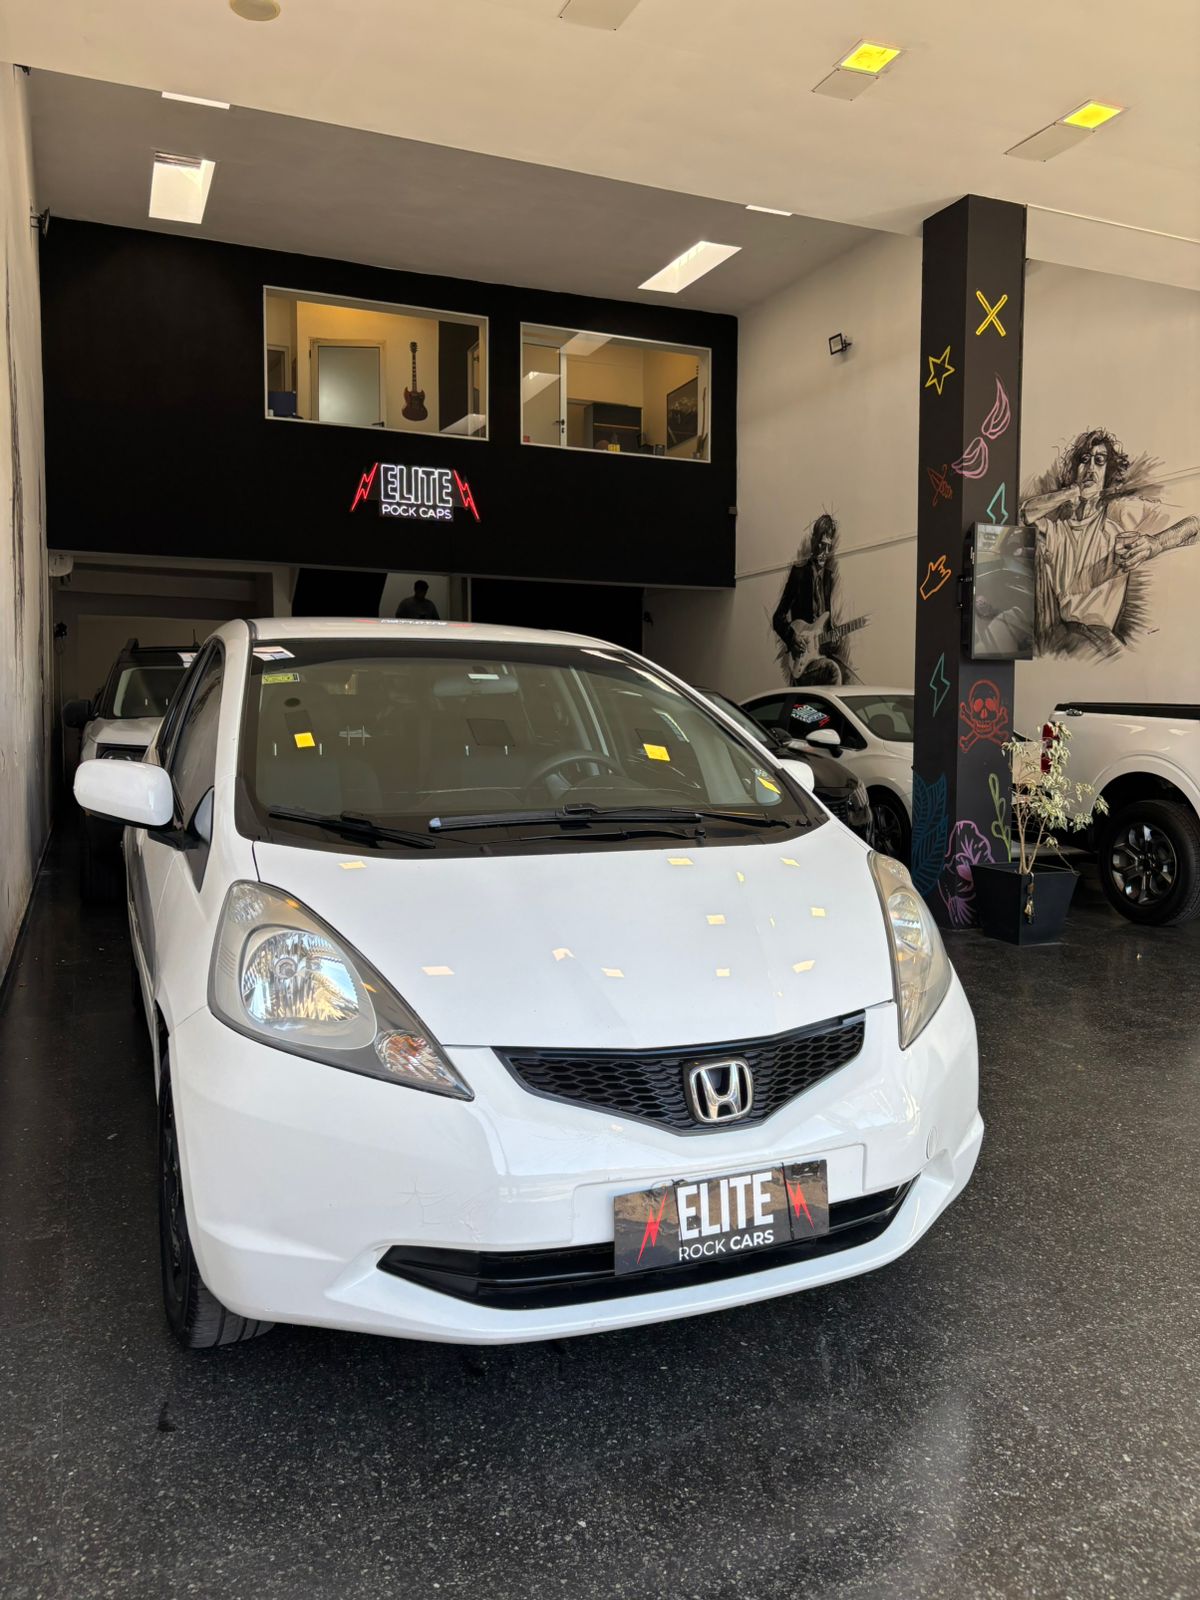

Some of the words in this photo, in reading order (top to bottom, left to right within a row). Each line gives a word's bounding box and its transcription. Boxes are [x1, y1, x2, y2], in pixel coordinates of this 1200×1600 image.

[380, 464, 453, 507] ELITE
[677, 1171, 774, 1241] ELITE
[678, 1239, 726, 1261] ROCK
[730, 1230, 774, 1250] CARS
